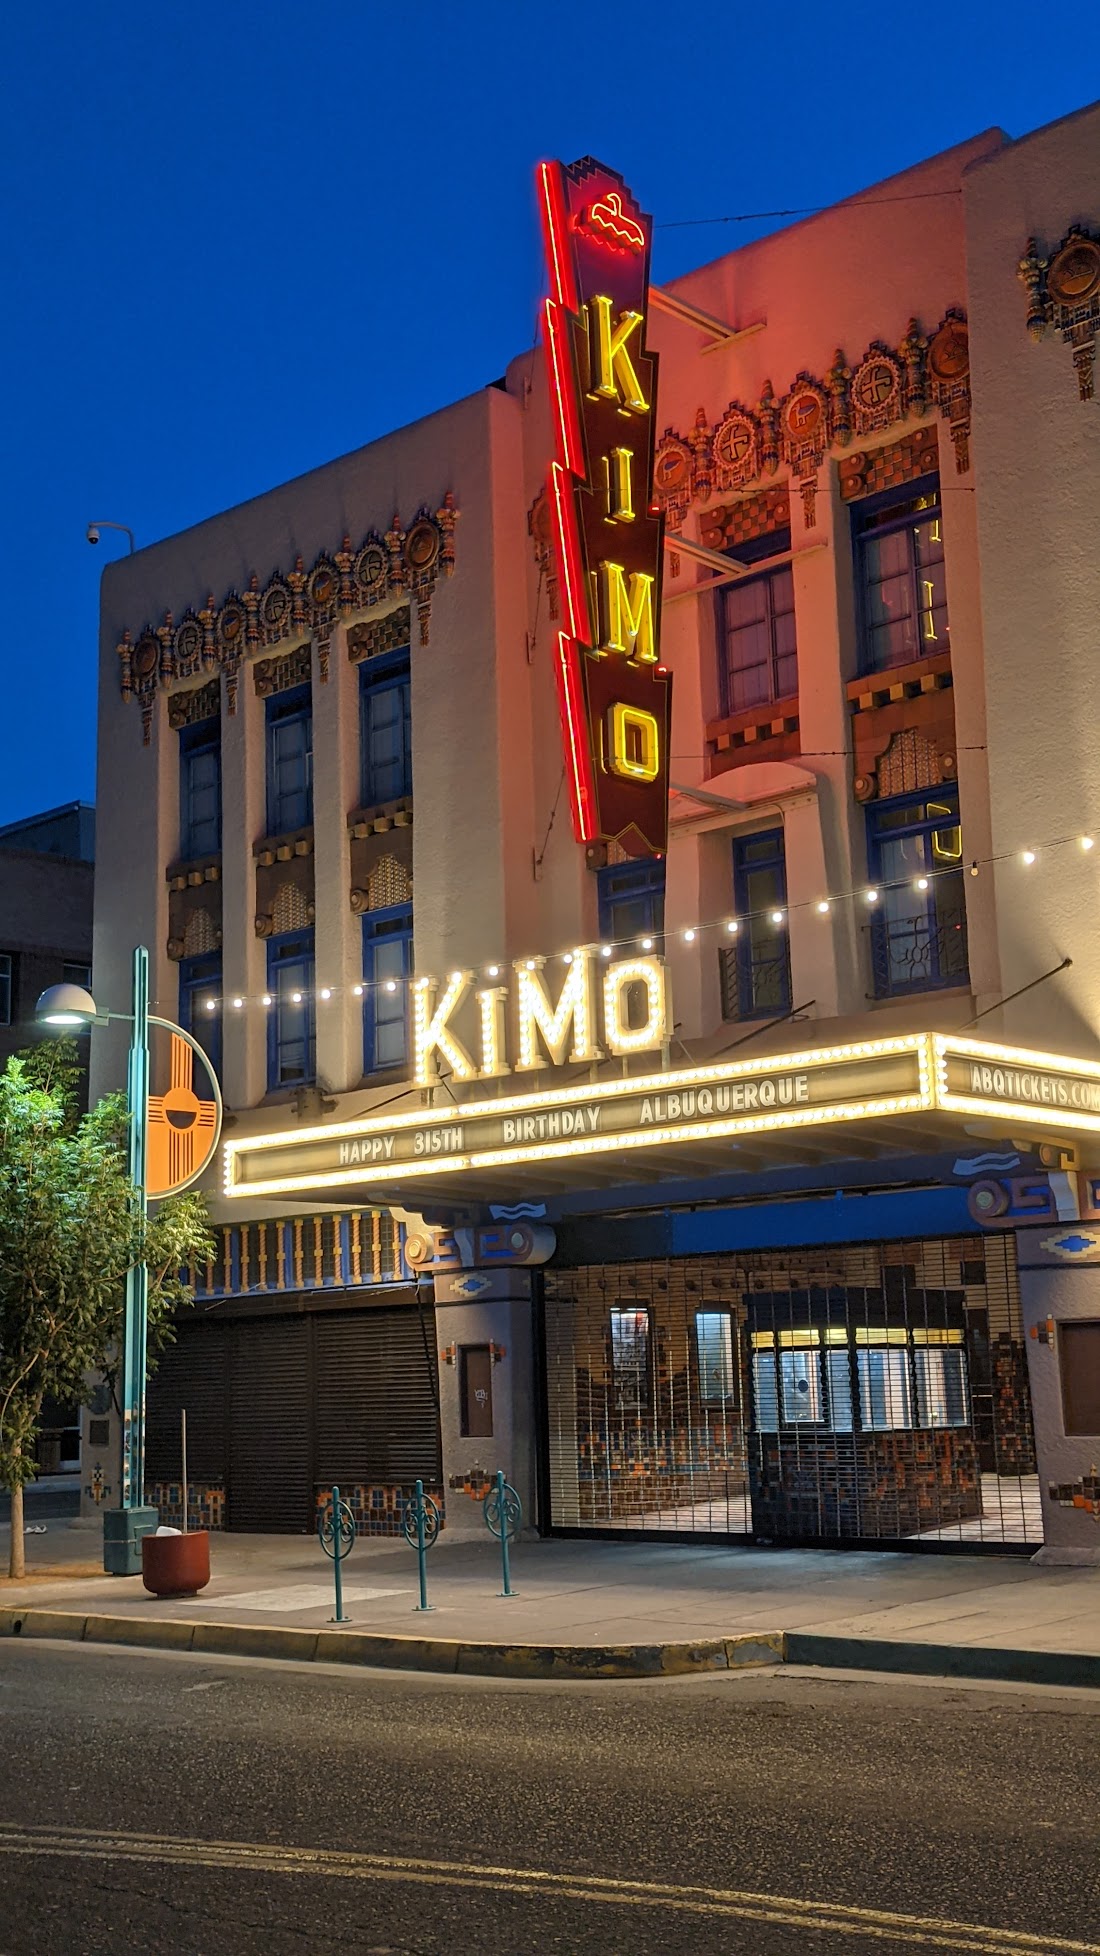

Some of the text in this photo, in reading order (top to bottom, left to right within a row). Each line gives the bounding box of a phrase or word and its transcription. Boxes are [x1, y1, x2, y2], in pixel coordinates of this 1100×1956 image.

[590, 295, 660, 784] KIMO
[410, 943, 674, 1090] KIMO
[340, 1075, 809, 1164] HAPPY 315TH BIRTHDAY ALBUQUERQUE
